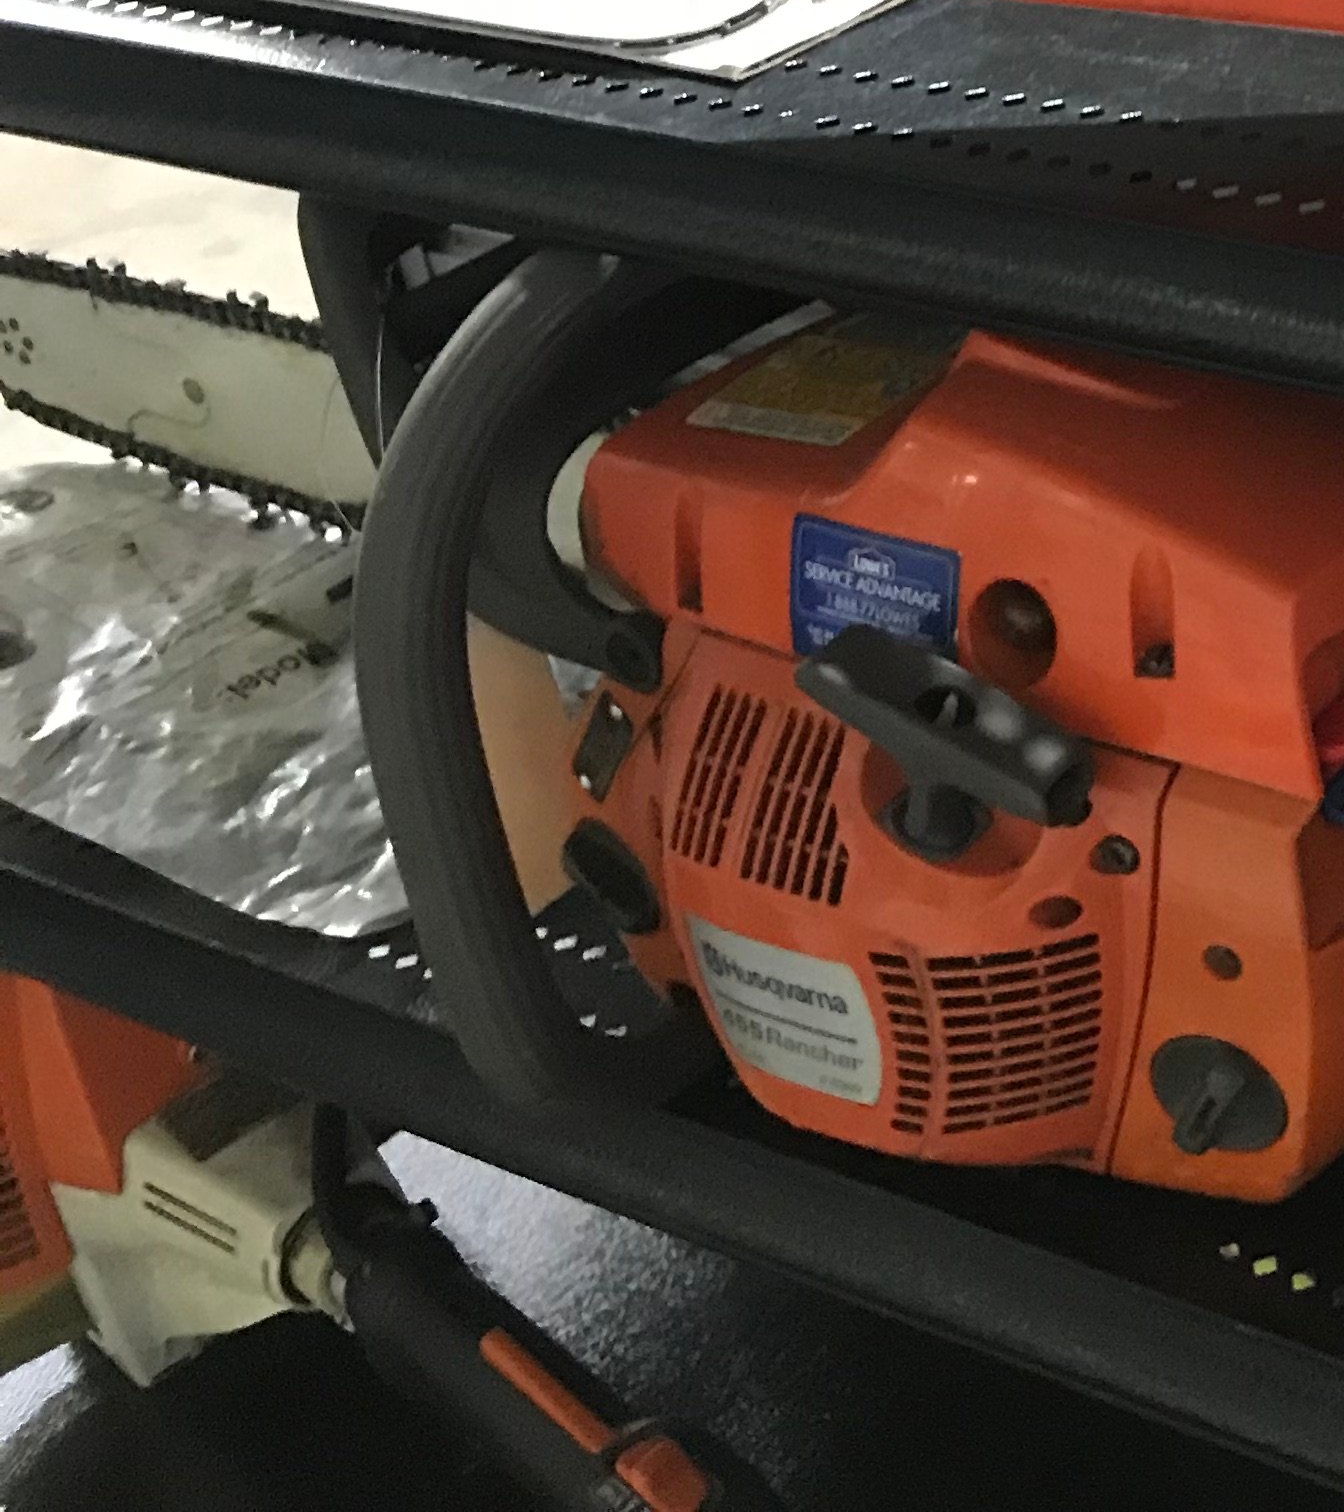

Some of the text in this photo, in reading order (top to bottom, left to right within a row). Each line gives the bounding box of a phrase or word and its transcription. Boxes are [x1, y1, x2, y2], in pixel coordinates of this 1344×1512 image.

[804, 559, 942, 613] SERVICE ADVANTAGE
[721, 952, 849, 1016] Husqvarna
[765, 1025, 866, 1072] Rancher
